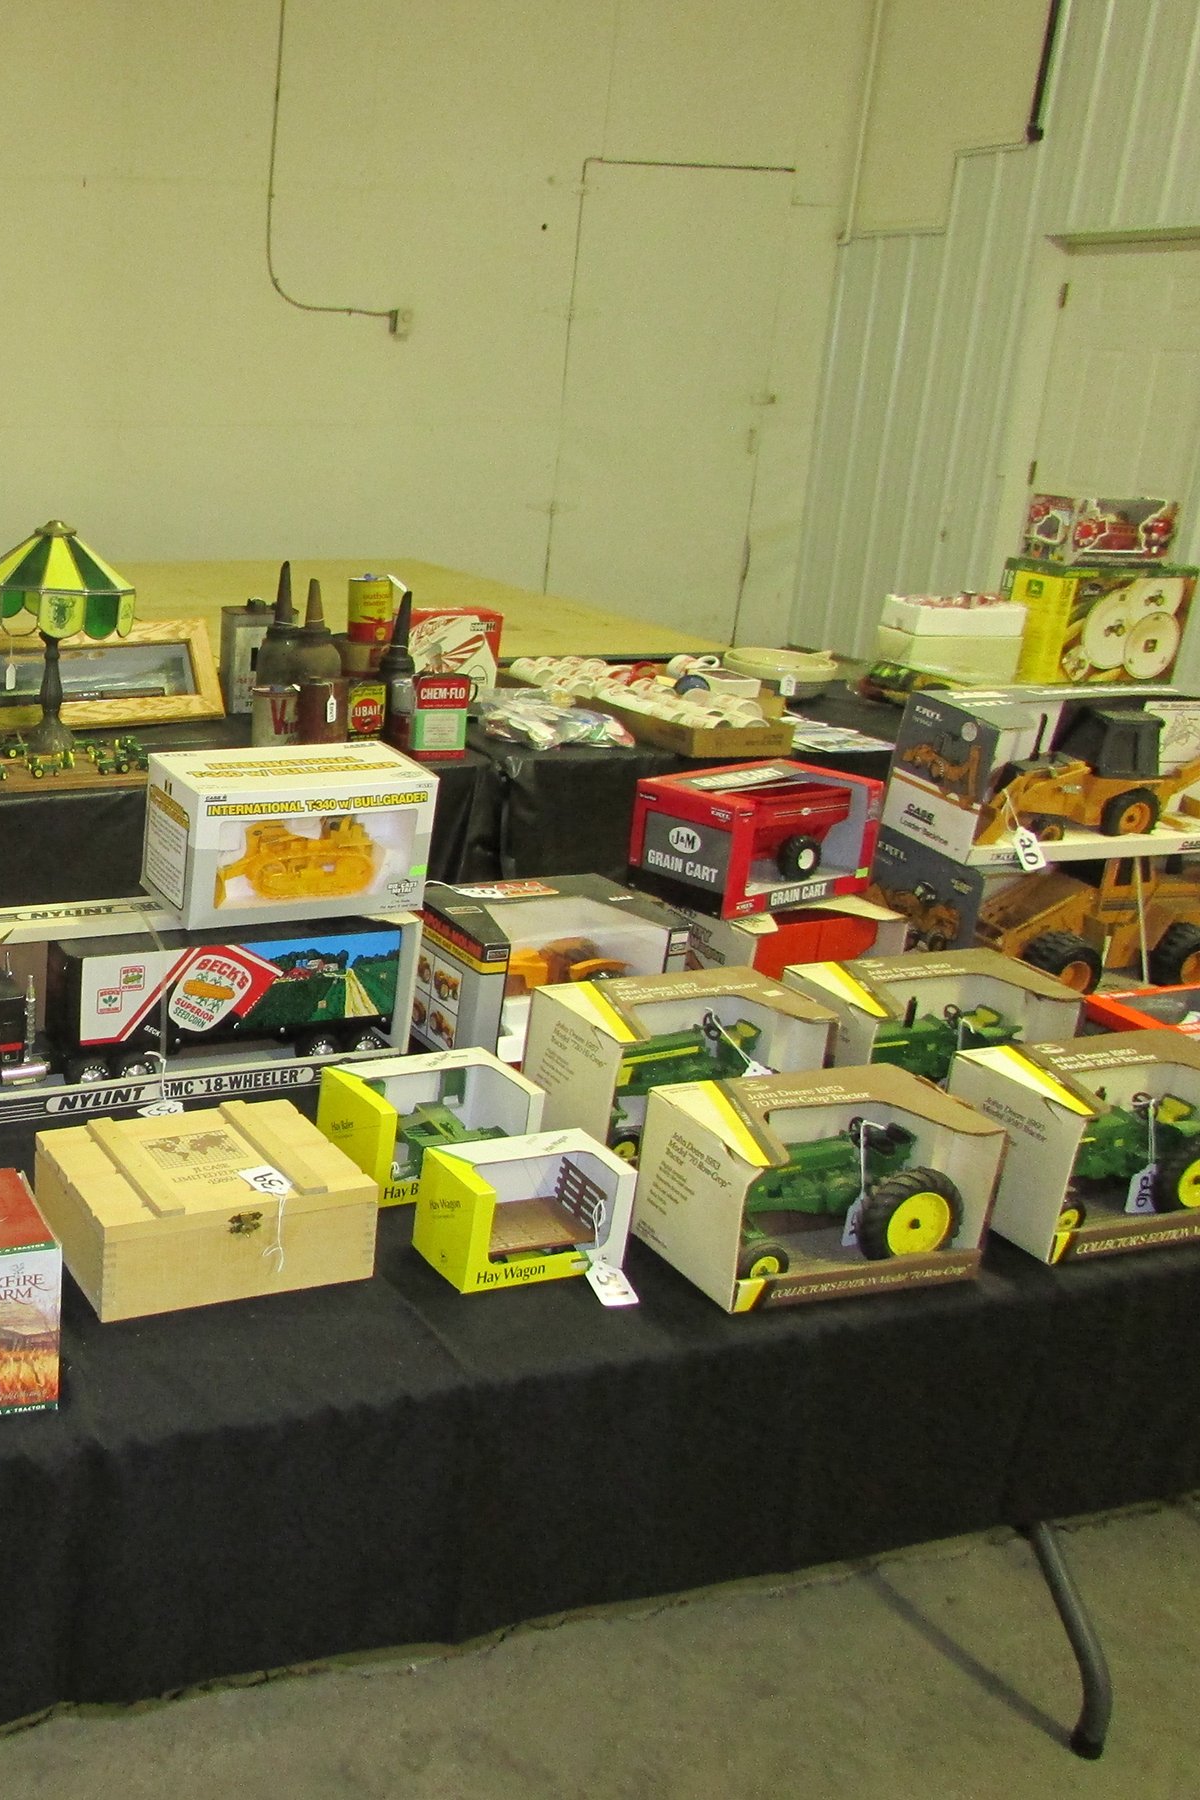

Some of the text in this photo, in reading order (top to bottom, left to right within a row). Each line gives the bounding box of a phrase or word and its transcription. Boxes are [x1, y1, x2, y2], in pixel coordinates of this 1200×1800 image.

[420, 687, 466, 700] CHEM-FLO
[205, 756, 360, 770] INTERNATIONAL
[269, 760, 402, 777] BULLGRADER
[206, 800, 304, 816] INTERNATIONAL
[306, 798, 336, 812] T-340
[354, 791, 429, 808] BULLGRADER
[906, 802, 936, 820] CASE
[671, 830, 696, 850] J&M
[1019, 836, 1039, 865] 20
[647, 848, 719, 884] GRAIN CART
[770, 882, 828, 906] GRAIN CART
[30, 905, 116, 920] NYLINT
[195, 958, 250, 990] BECK'S
[867, 968, 892, 976] John
[616, 986, 673, 997] John Deere
[620, 982, 759, 1002] Model Tractor
[174, 997, 215, 1023] SUPERIOR
[554, 1020, 585, 1043] John Deere
[554, 1028, 570, 1043] Model
[1050, 1052, 1108, 1065] John Deere
[1058, 1061, 1094, 1071] Model
[1122, 1054, 1158, 1064] Tractor
[58, 1086, 146, 1112] NYLINT
[160, 1080, 195, 1098] GMC
[747, 1085, 846, 1101] John Deere 1953
[752, 1091, 871, 1108] 70 Tractor
[1004, 1104, 1026, 1120] Deere
[665, 1146, 684, 1167] Tractor
[668, 1140, 688, 1158] Model
[672, 1132, 722, 1171] John Deere 1953
[202, 1162, 231, 1172] CASE
[172, 1171, 216, 1184] LIMITED
[383, 1186, 406, 1200] Hay
[429, 1198, 462, 1211] Hay Wagon
[12, 1242, 46, 1252] TRACTOR
[1076, 1234, 1148, 1255] COLLECTOR'S
[476, 1263, 546, 1286] Hay Wagon
[14, 1404, 46, 1414] TRACTOR
